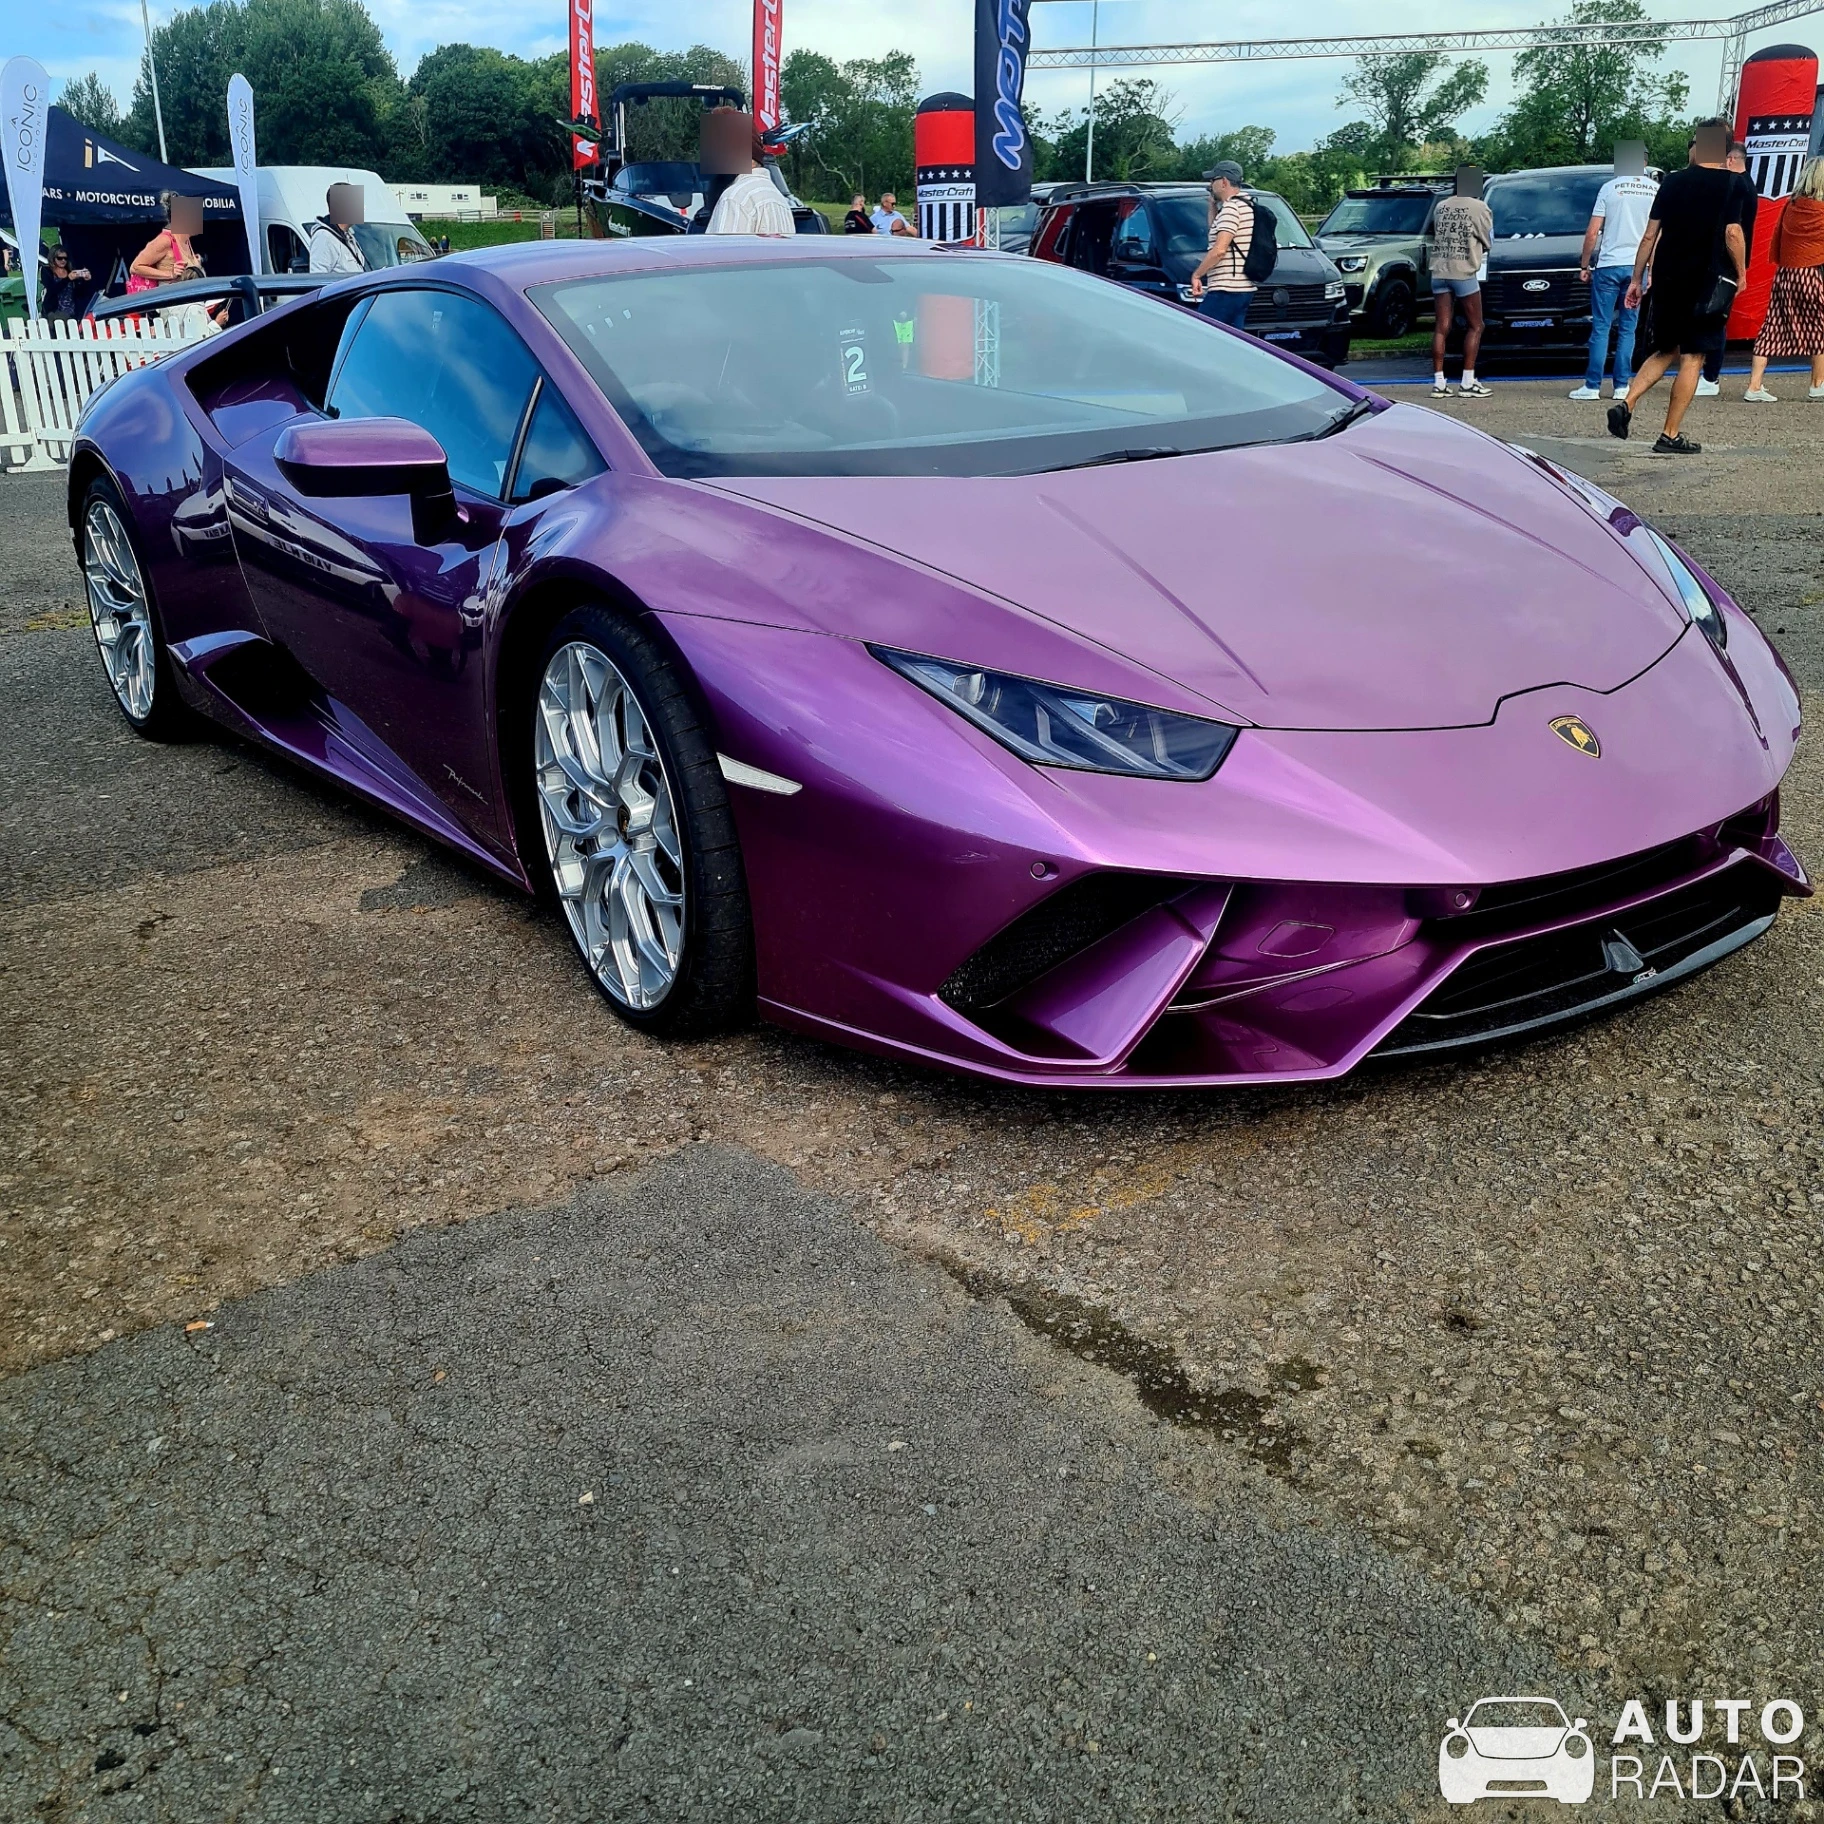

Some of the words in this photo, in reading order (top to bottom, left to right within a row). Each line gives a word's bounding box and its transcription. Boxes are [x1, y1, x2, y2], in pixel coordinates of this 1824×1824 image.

[16, 84, 38, 172] ICONIC
[239, 98, 249, 176] ICONIC
[42, 187, 63, 200] ARS
[75, 190, 155, 207] MOTORCYCLES
[844, 346, 867, 383] 2
